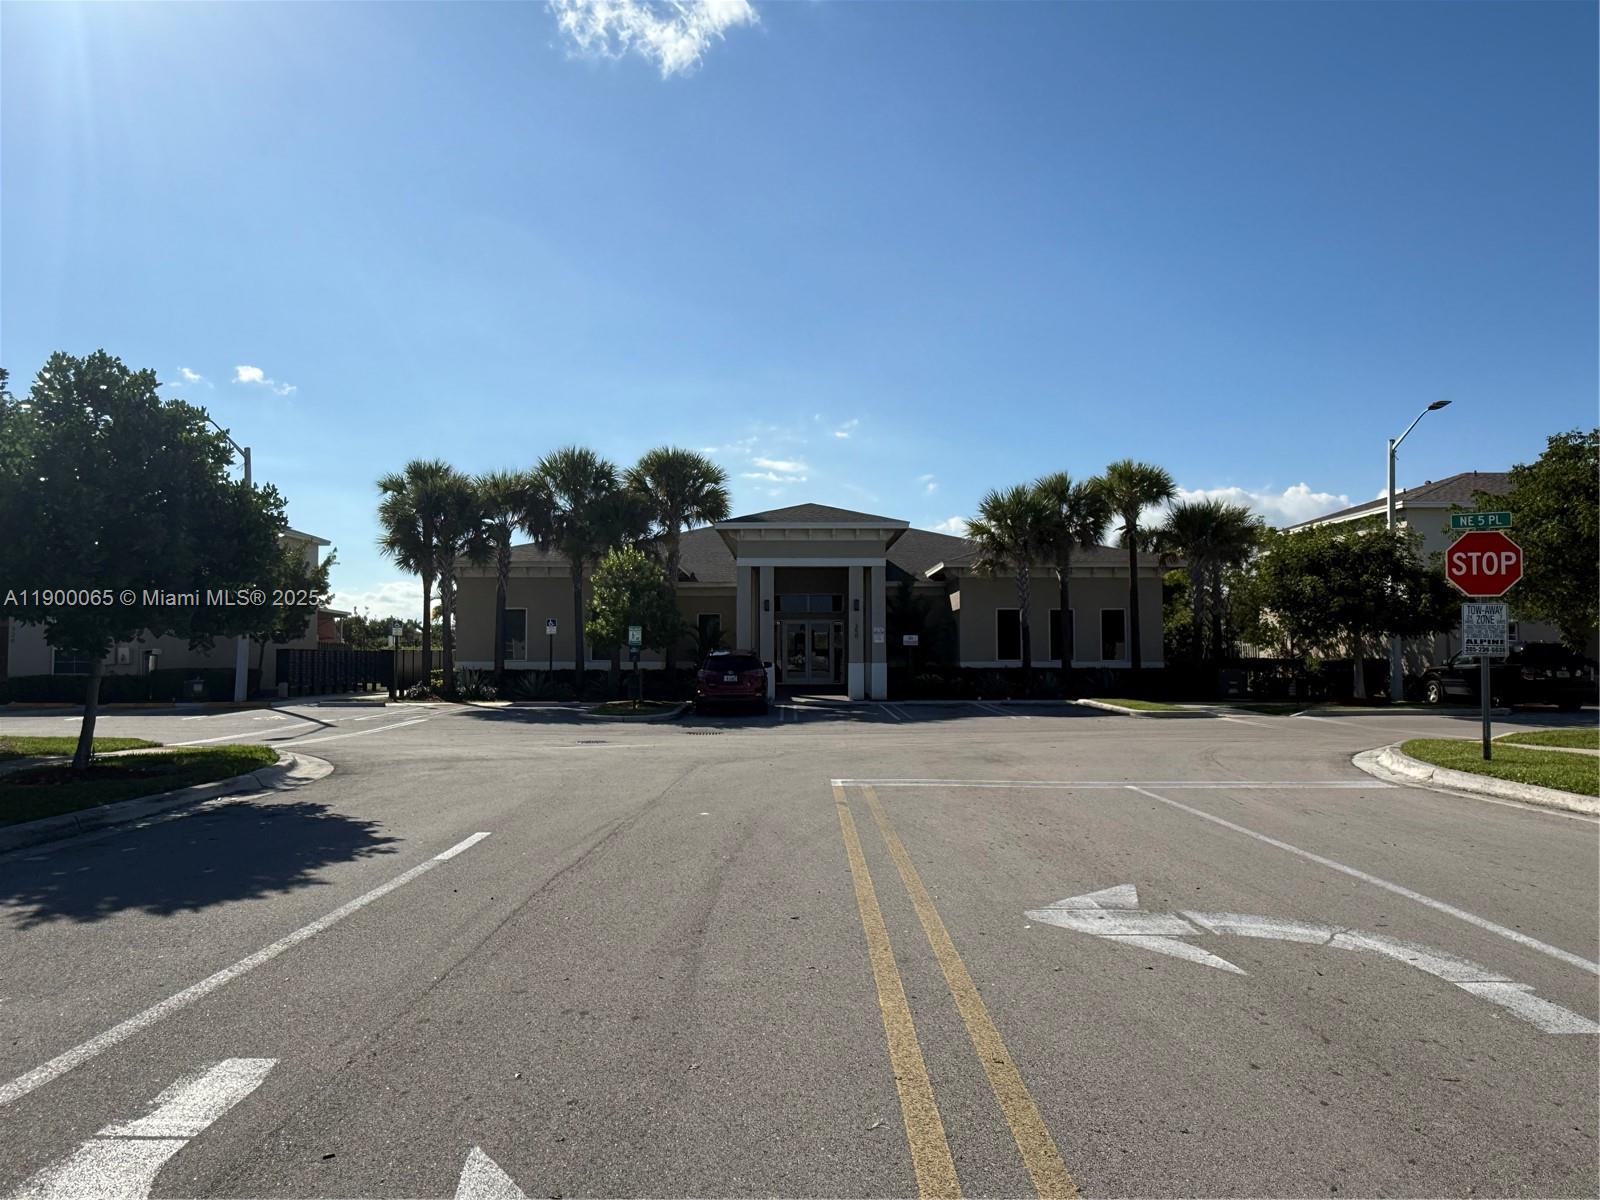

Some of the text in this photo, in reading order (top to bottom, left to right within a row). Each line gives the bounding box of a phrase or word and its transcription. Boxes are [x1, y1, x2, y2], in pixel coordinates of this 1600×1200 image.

[1459, 515, 1503, 526] NE 5 PL
[1451, 551, 1517, 576] STOP
[1467, 605, 1503, 615] TOW-AWAY
[1476, 615, 1496, 624] ZONE
